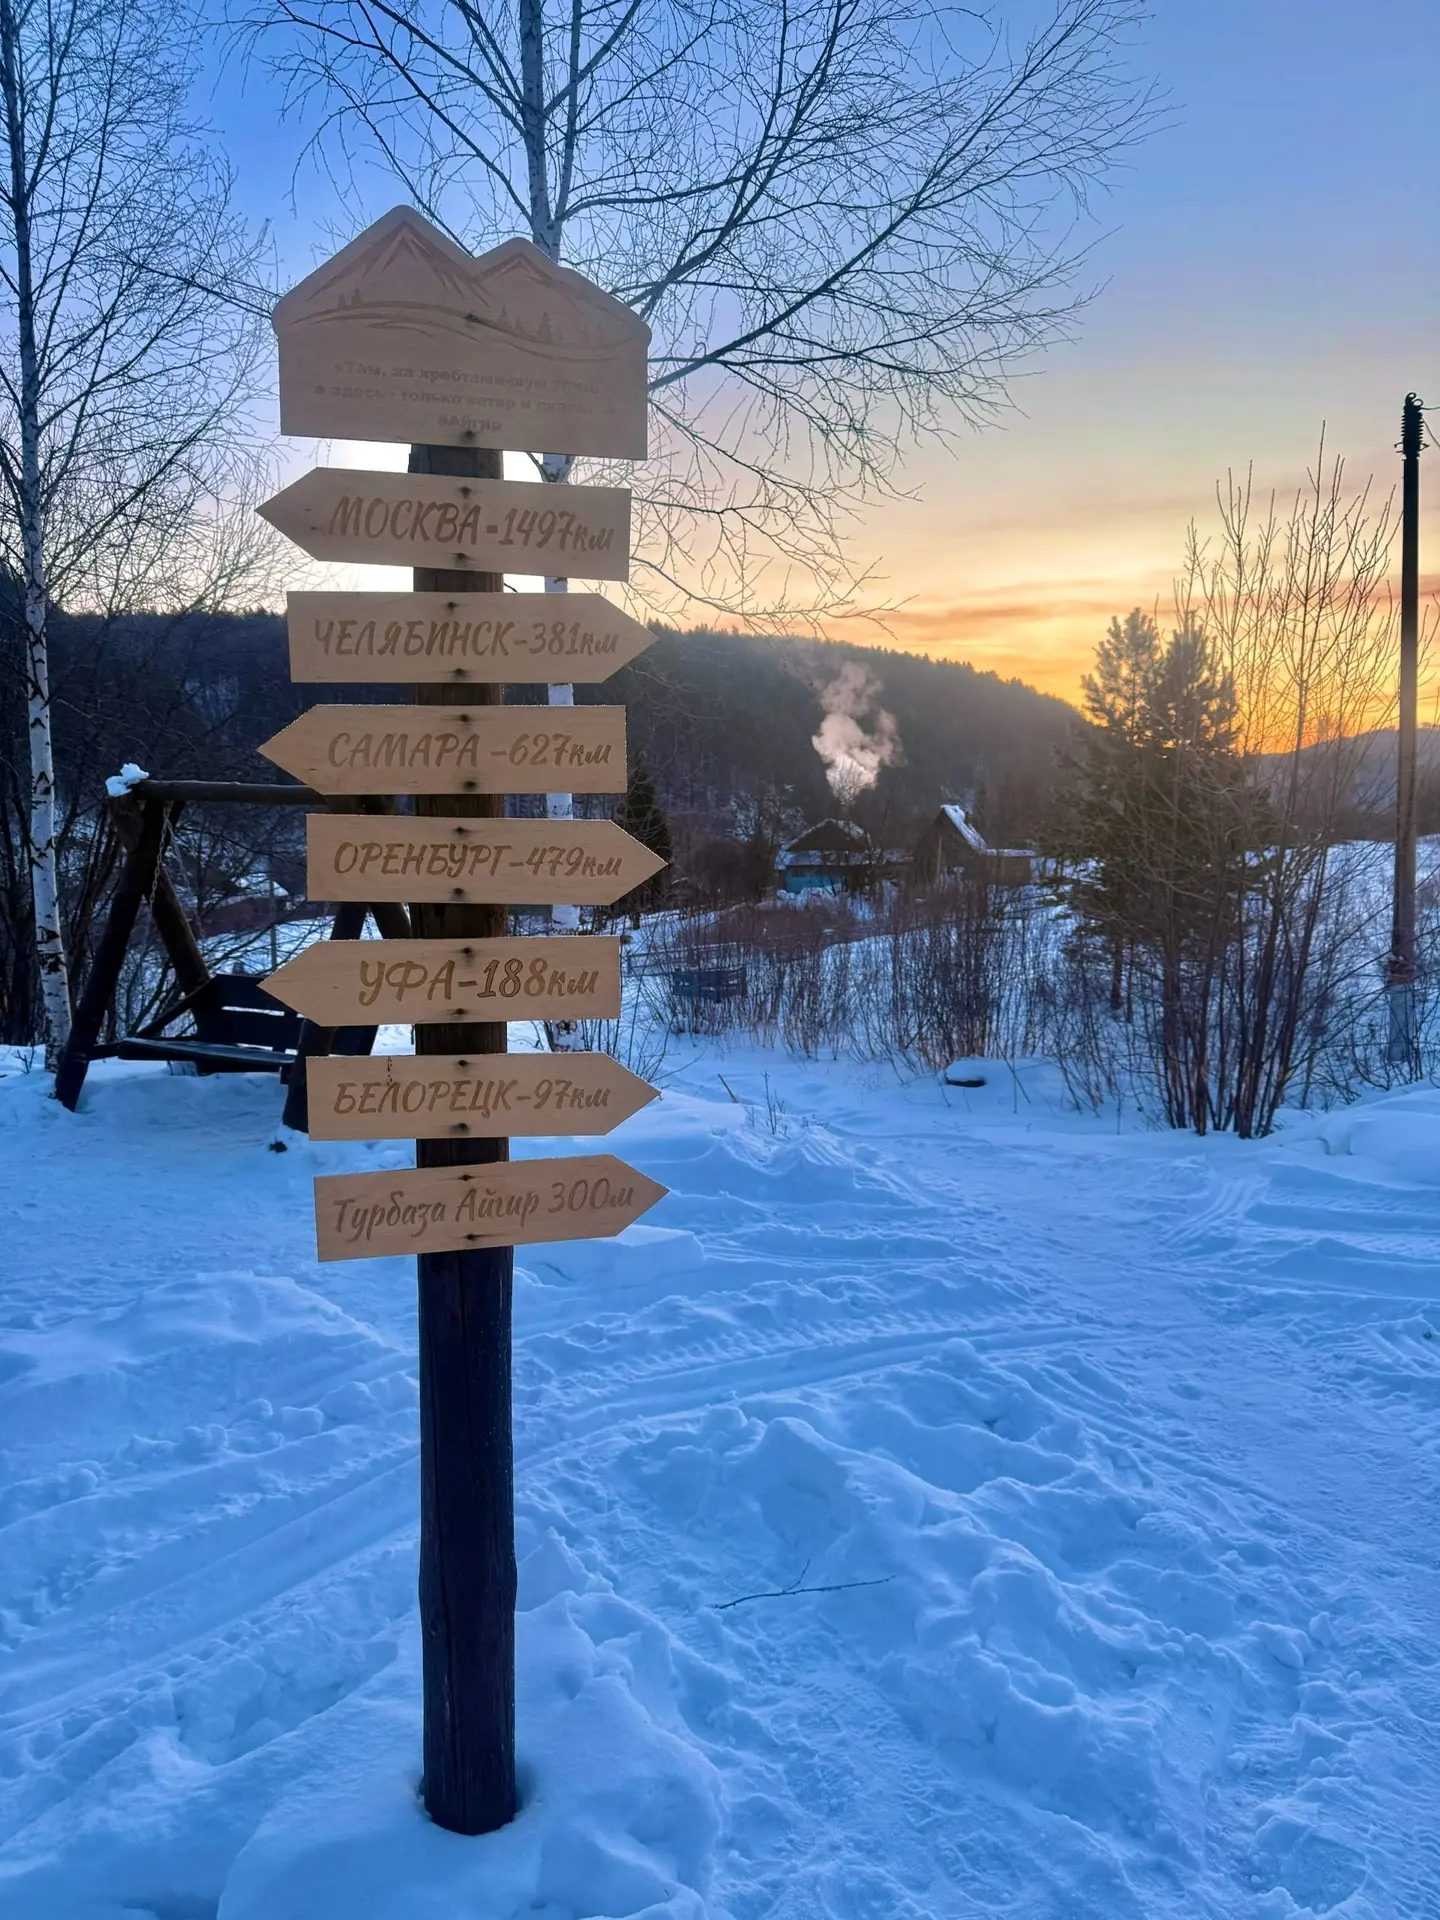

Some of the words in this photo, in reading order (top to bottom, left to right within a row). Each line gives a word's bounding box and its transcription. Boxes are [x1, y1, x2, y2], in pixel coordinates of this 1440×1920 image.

[391, 367, 413, 378] за
[401, 391, 462, 404] только
[467, 397, 515, 411] ветер
[521, 399, 532, 410] и
[333, 1190, 446, 1243] Турбаза
[455, 1187, 540, 1228] Айгир
[548, 1177, 634, 1214] 300м
